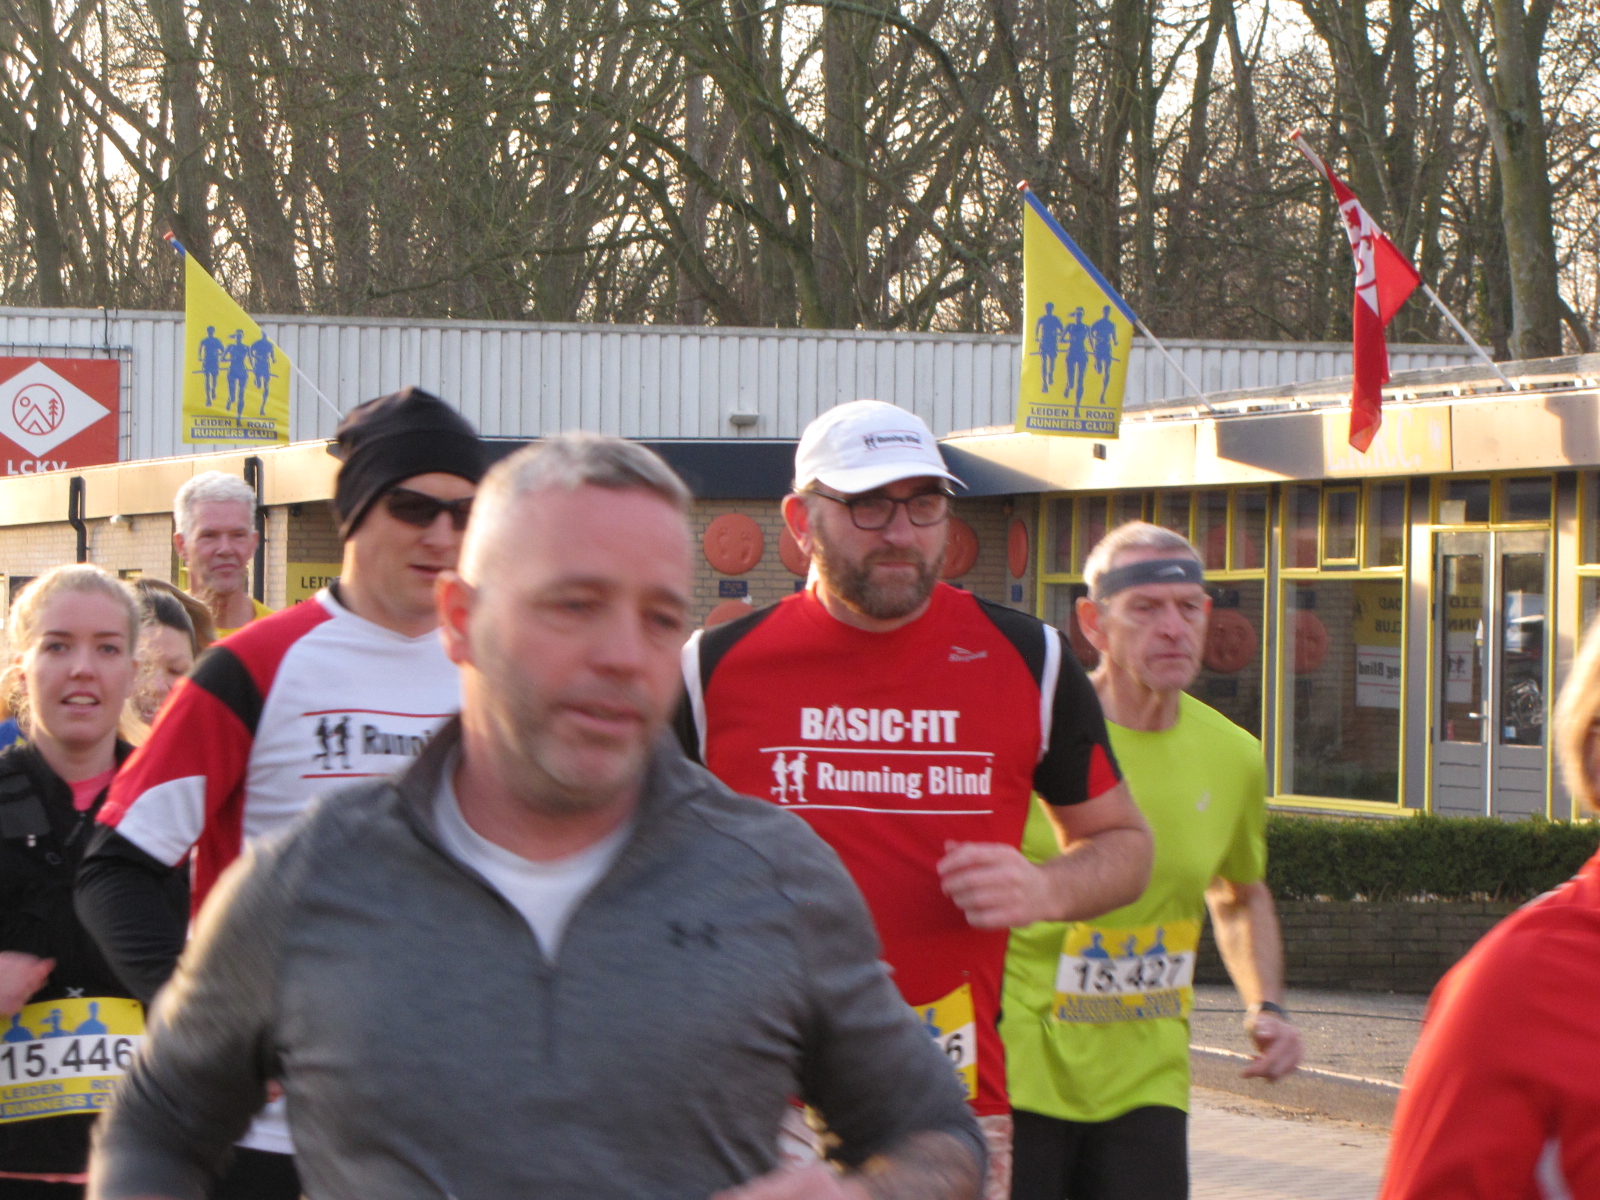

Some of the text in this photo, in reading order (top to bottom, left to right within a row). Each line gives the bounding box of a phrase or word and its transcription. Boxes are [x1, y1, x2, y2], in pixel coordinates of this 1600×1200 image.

[1031, 406, 1115, 419] LEIDEN ROAD
[194, 418, 275, 429] LEIDEN ROAD
[1029, 418, 1114, 431] RUNNERS CLUB
[194, 428, 275, 438] RUNNERS CLUB
[7, 459, 68, 475] LCKV
[801, 704, 960, 743] BASIC-FIT
[816, 762, 992, 799] Running Blind
[1074, 954, 1184, 991] 15.427
[0, 1038, 134, 1080] 15.446
[2, 1083, 63, 1100] LEIDEN
